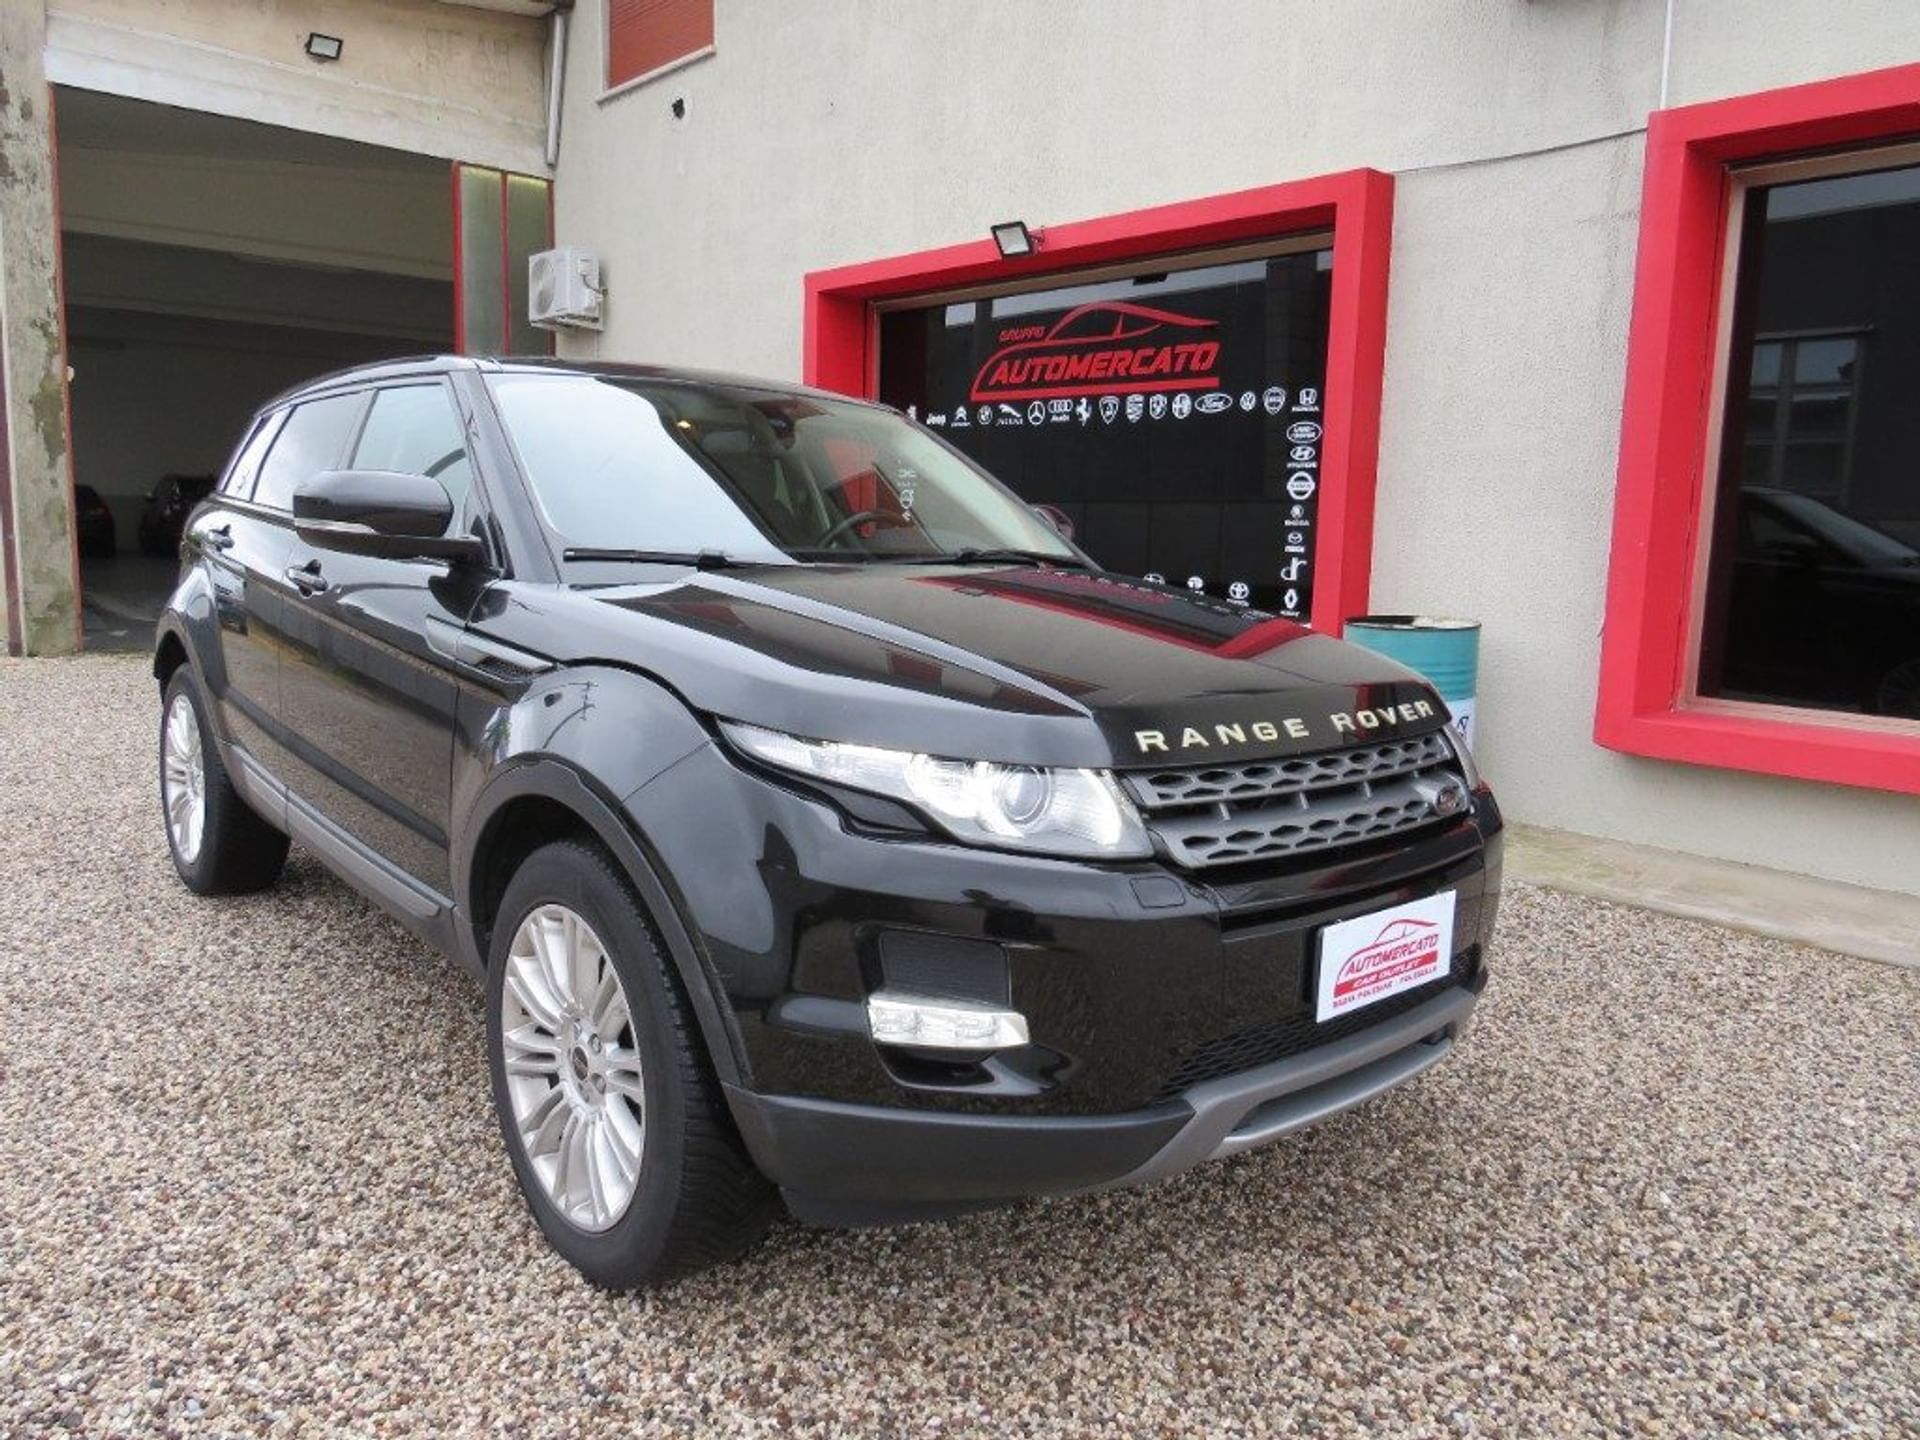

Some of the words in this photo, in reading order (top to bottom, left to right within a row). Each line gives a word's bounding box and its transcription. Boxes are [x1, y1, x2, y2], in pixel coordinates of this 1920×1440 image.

[989, 342, 1220, 386] AUTOMERCATO
[1134, 717, 1310, 753] RANGE
[1330, 700, 1435, 732] ROVER
[1344, 933, 1440, 977] AUTOMERCATO
